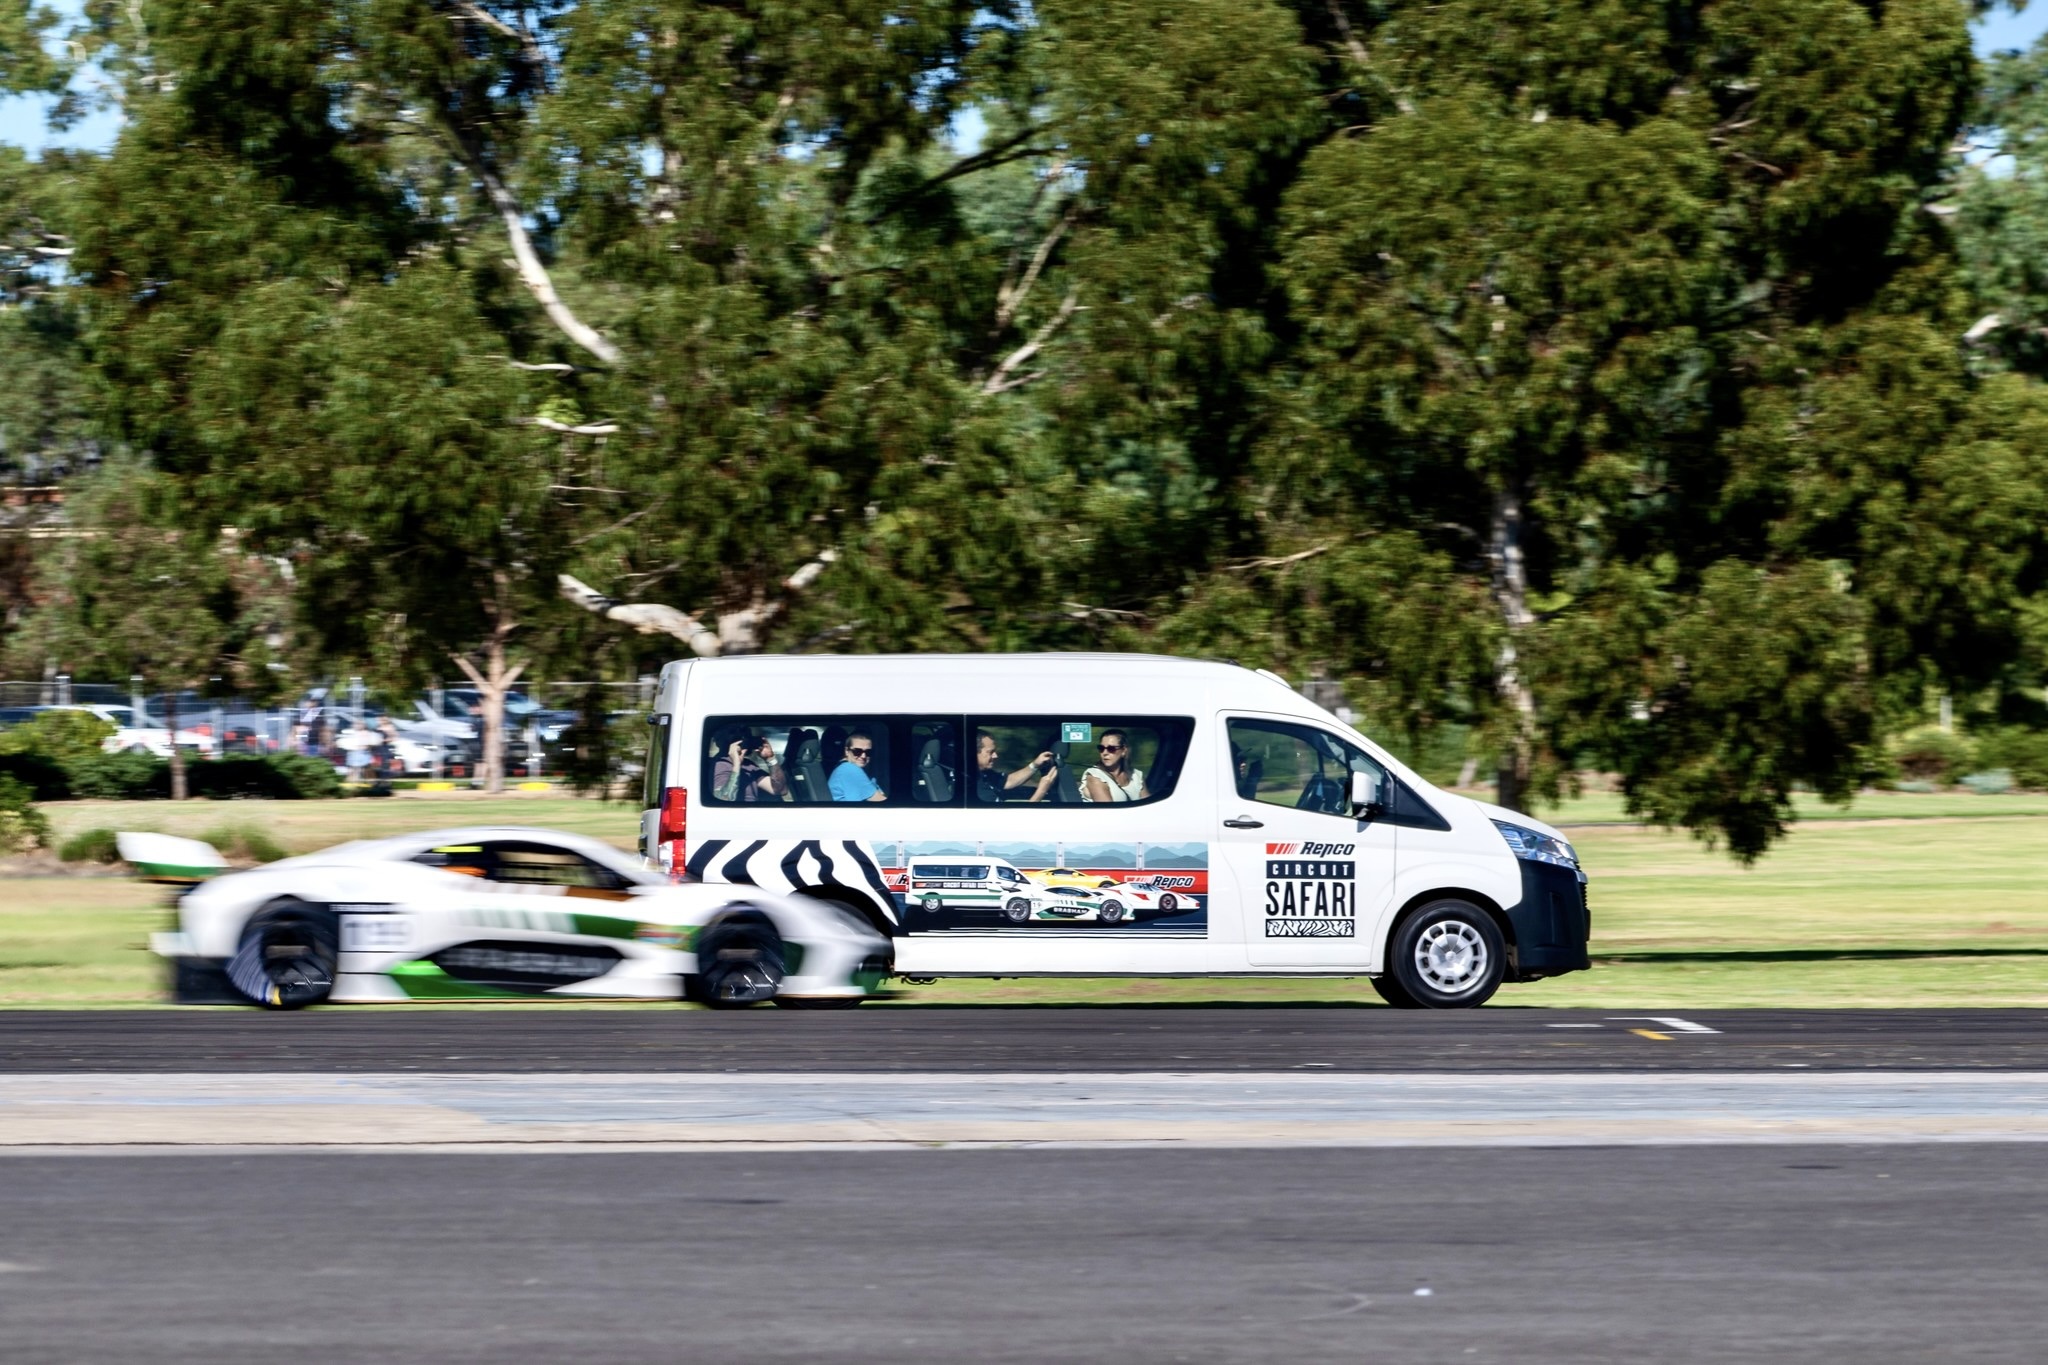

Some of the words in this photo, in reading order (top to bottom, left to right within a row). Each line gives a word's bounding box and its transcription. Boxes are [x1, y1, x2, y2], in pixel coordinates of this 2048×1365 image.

[1300, 842, 1355, 858] Repco
[1272, 864, 1349, 876] CIRCUIT
[1152, 875, 1194, 888] Repco
[1265, 881, 1355, 917] SAFARI
